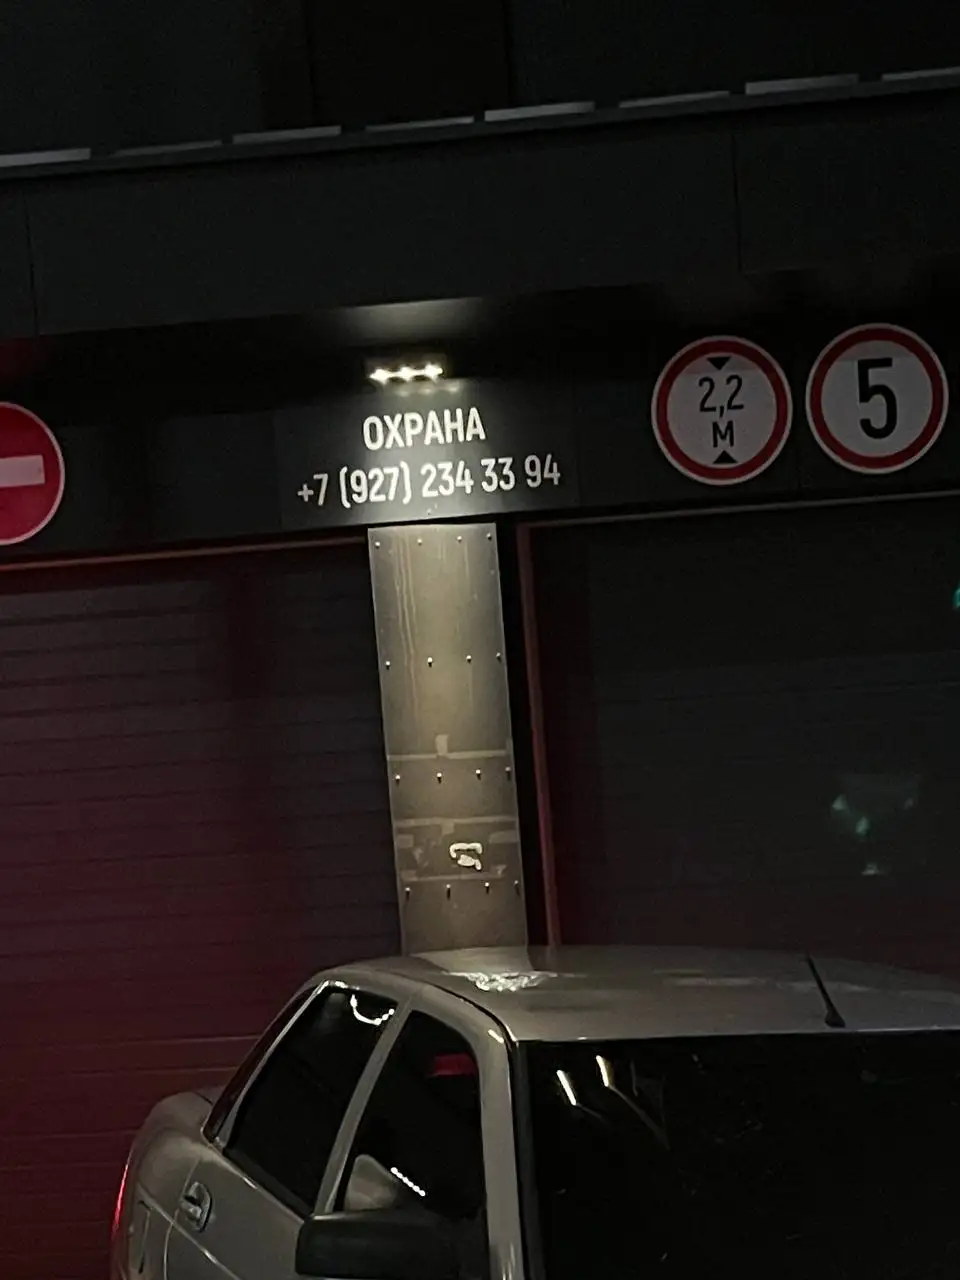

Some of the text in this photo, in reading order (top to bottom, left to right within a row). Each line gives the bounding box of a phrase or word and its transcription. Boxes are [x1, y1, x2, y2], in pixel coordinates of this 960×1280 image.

[698, 375, 744, 418] 2,2
[858, 357, 898, 440] 5
[362, 407, 487, 451] ОХРАНА
[711, 420, 735, 448] М
[297, 453, 562, 509] +7 (927) 234 33 94
